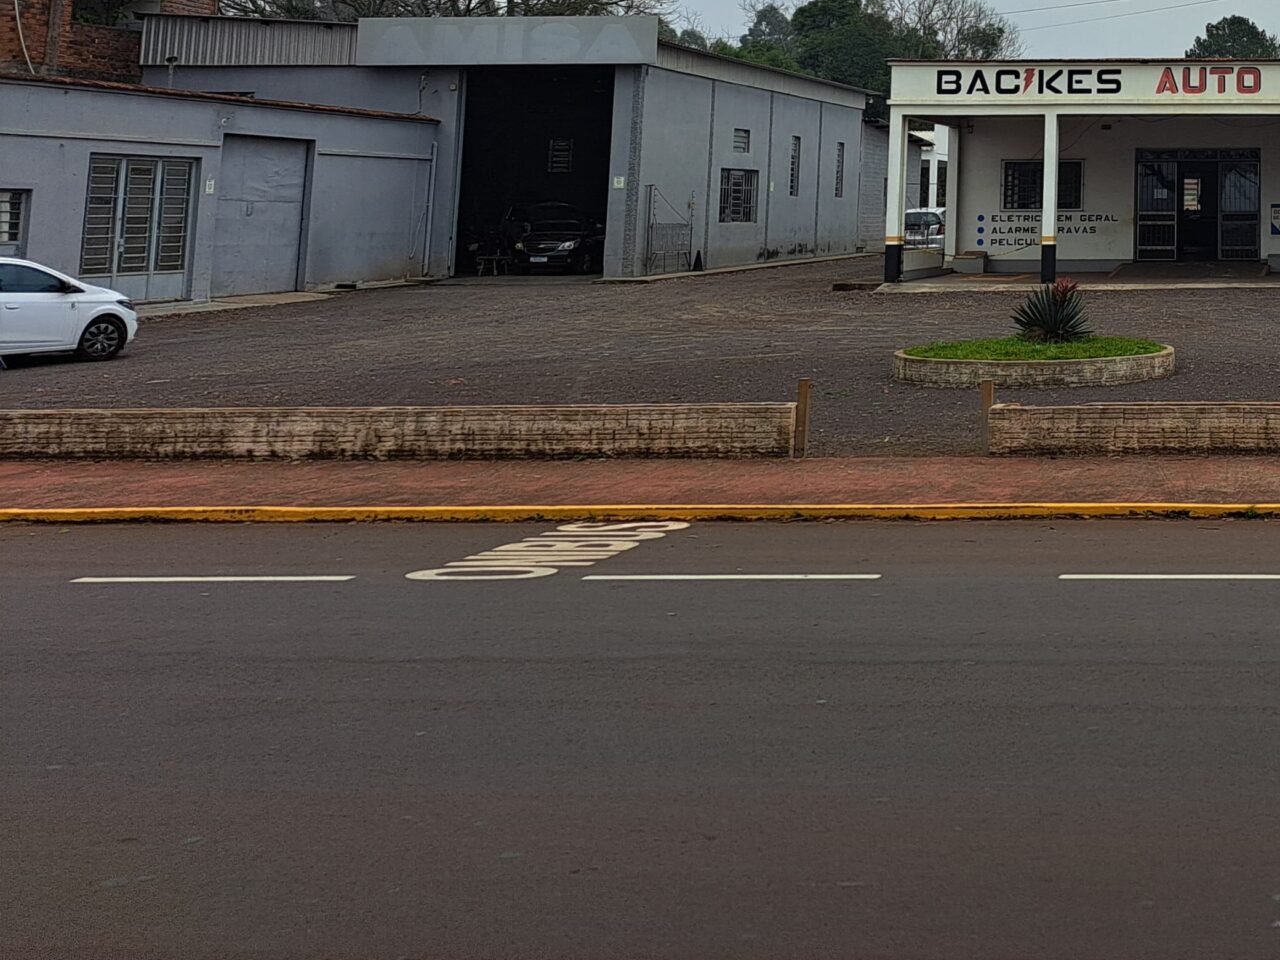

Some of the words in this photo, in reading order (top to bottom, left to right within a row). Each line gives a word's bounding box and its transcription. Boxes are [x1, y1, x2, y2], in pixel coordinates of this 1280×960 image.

[1156, 66, 1262, 95] AUTO
[991, 214, 1042, 223] ELETRIC
[1080, 214, 1119, 222] GERAL
[991, 226, 1038, 235] ALARME
[1057, 225, 1097, 234] RAVAS
